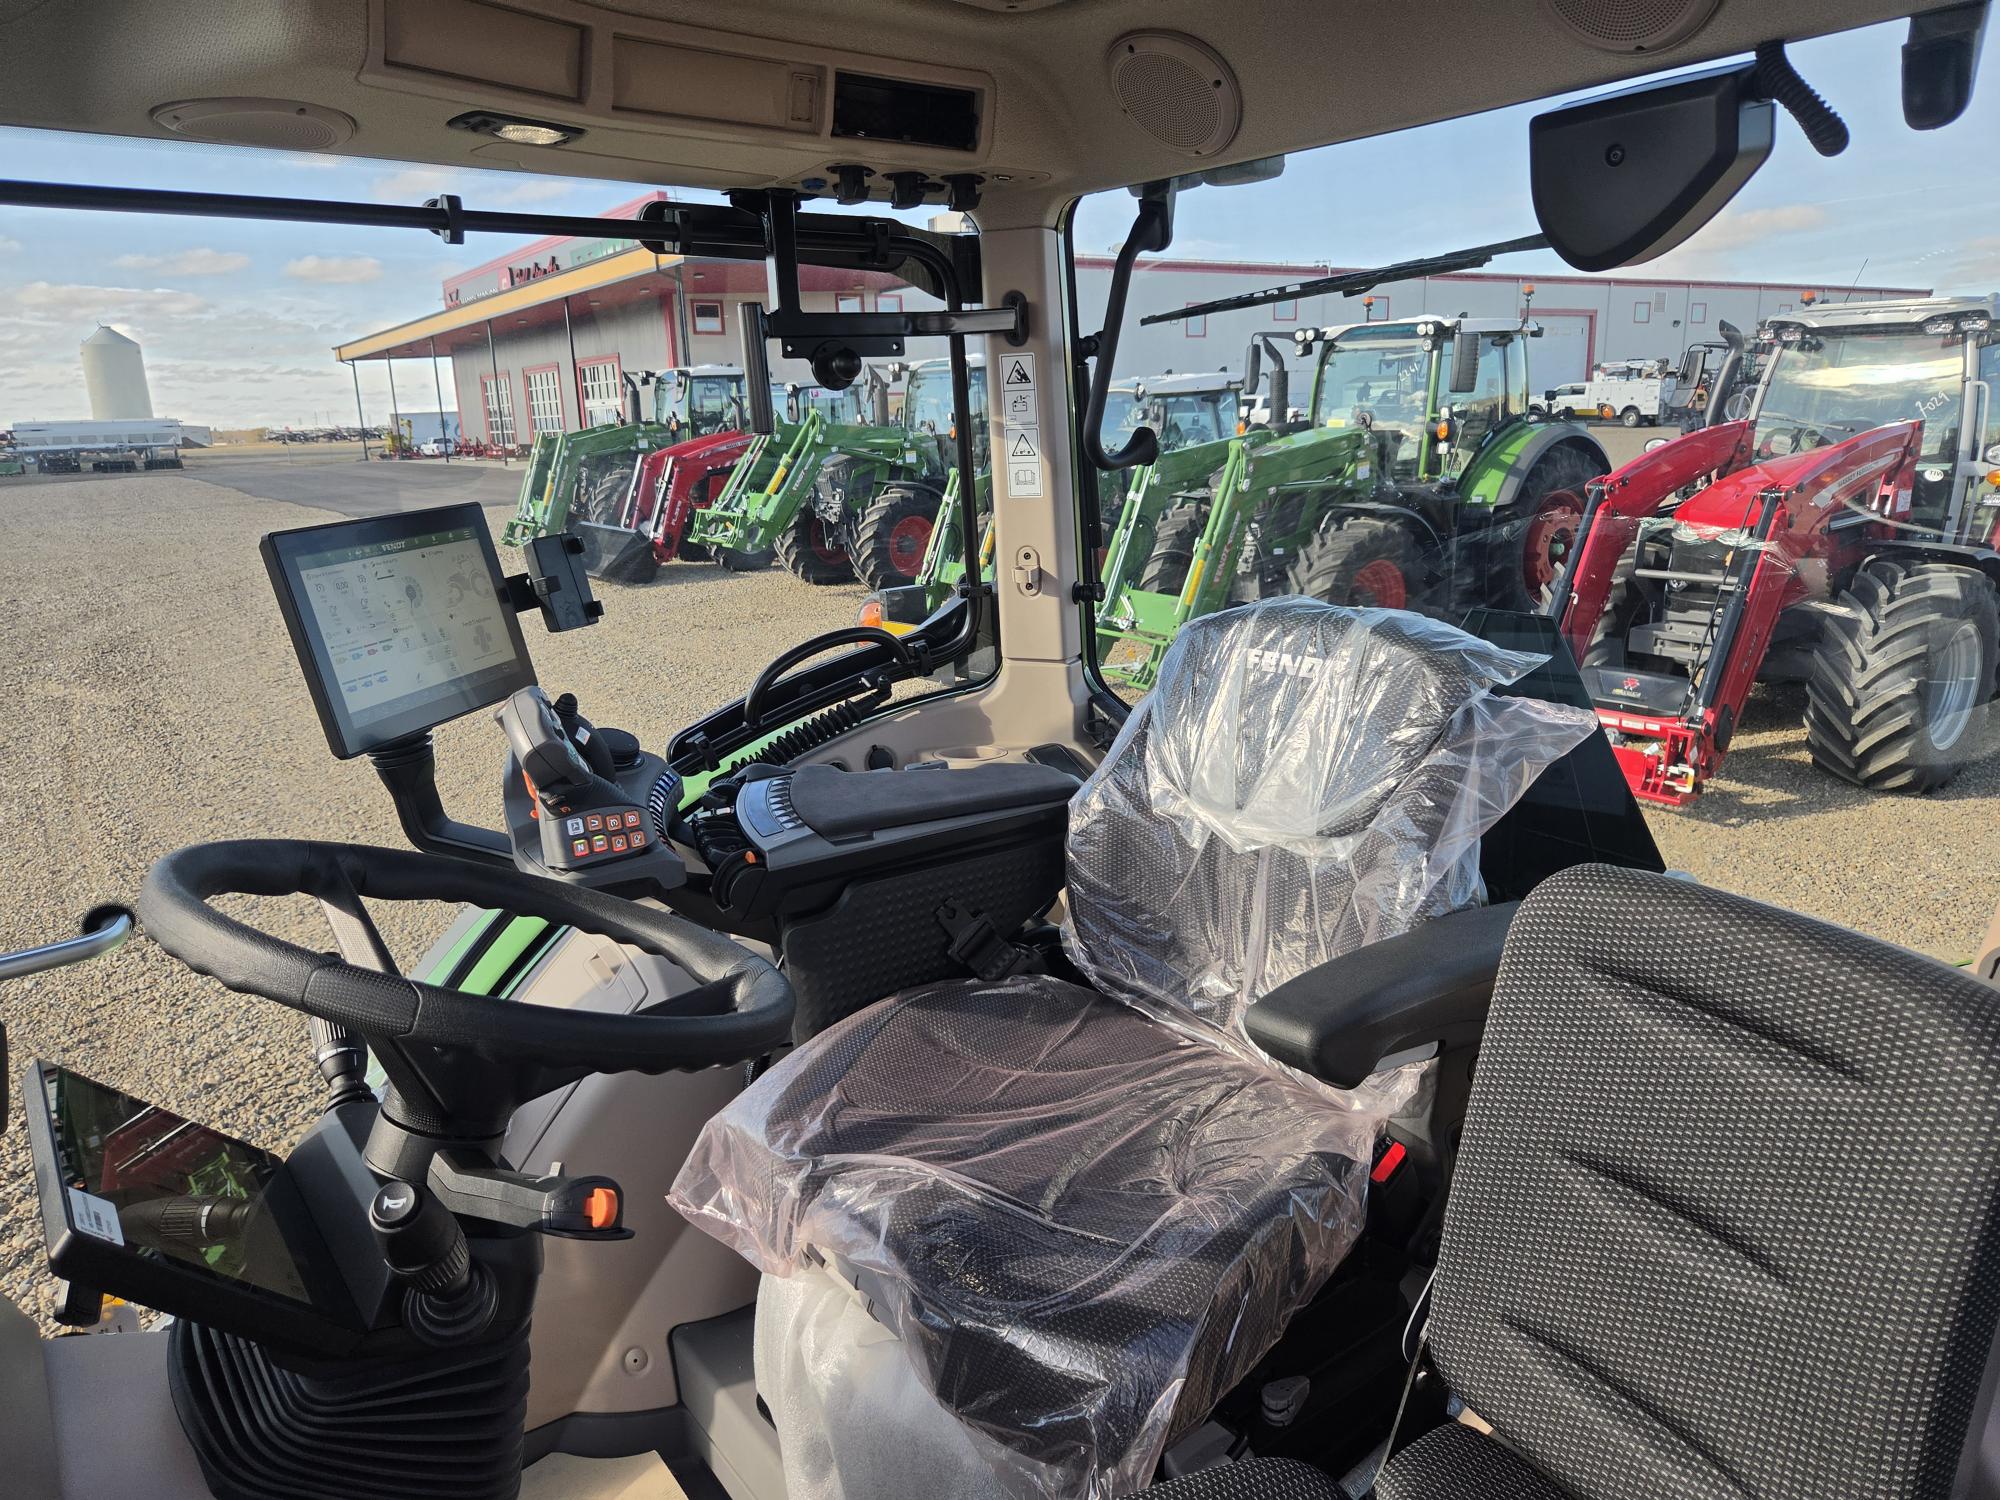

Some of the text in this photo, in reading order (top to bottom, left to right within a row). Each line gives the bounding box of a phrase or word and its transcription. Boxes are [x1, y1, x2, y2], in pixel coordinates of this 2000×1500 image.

[382, 540, 406, 552] FENDT
[1213, 543, 1231, 583] FENDT
[1246, 648, 1326, 680] FEND
